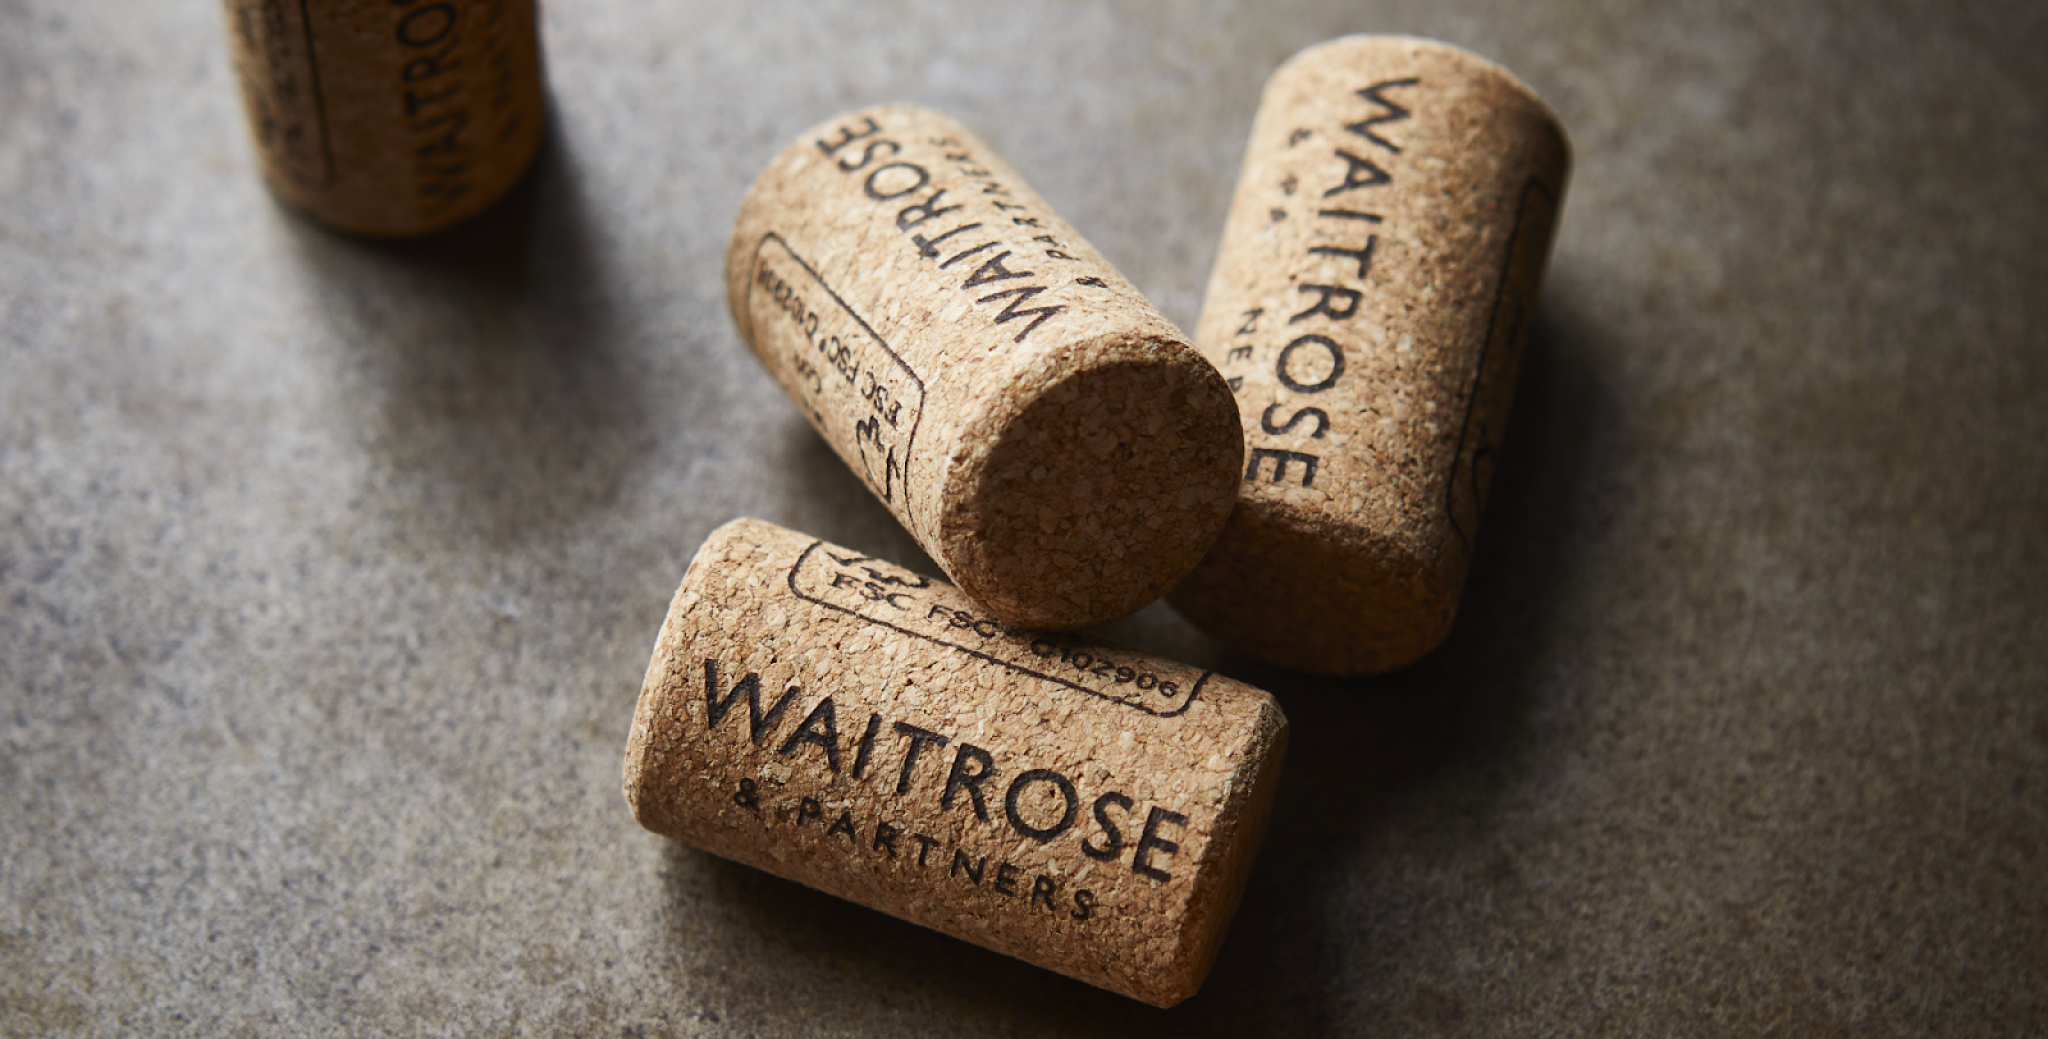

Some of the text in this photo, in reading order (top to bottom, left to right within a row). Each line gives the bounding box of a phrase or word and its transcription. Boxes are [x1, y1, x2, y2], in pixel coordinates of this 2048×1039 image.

[393, 0, 470, 220] WAITRO
[928, 136, 1082, 262] PARTNERS
[815, 115, 1066, 343] WAITROSE
[1246, 77, 1419, 488] WAITROSE
[860, 370, 902, 430] FSC
[831, 571, 915, 611] FSC
[1030, 638, 1178, 699] C102906
[703, 658, 1188, 883] WAITROSE
[734, 777, 1095, 920] & PARTNERS
